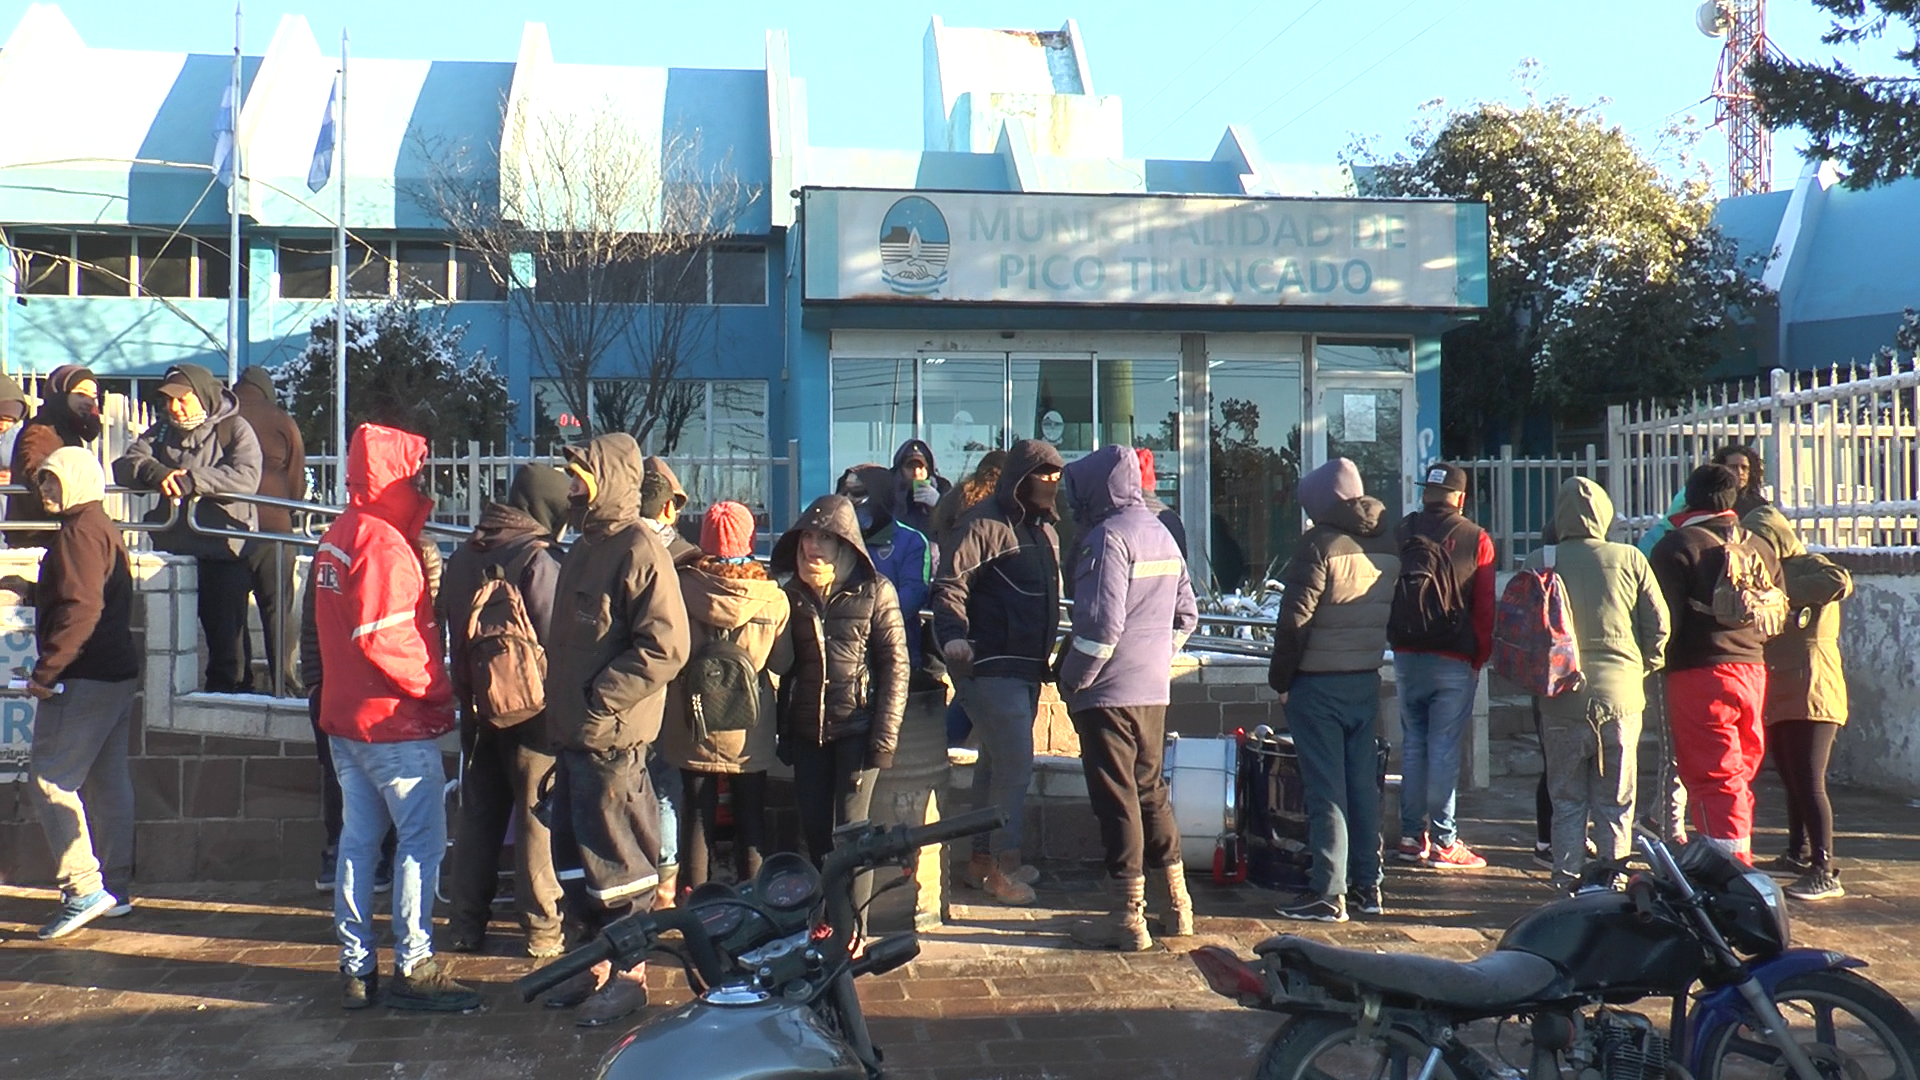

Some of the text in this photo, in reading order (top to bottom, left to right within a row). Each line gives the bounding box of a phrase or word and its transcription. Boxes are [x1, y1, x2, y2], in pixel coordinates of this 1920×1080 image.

[1353, 213, 1407, 249] DE
[1000, 254, 1373, 295] PICO TRUNCADO
